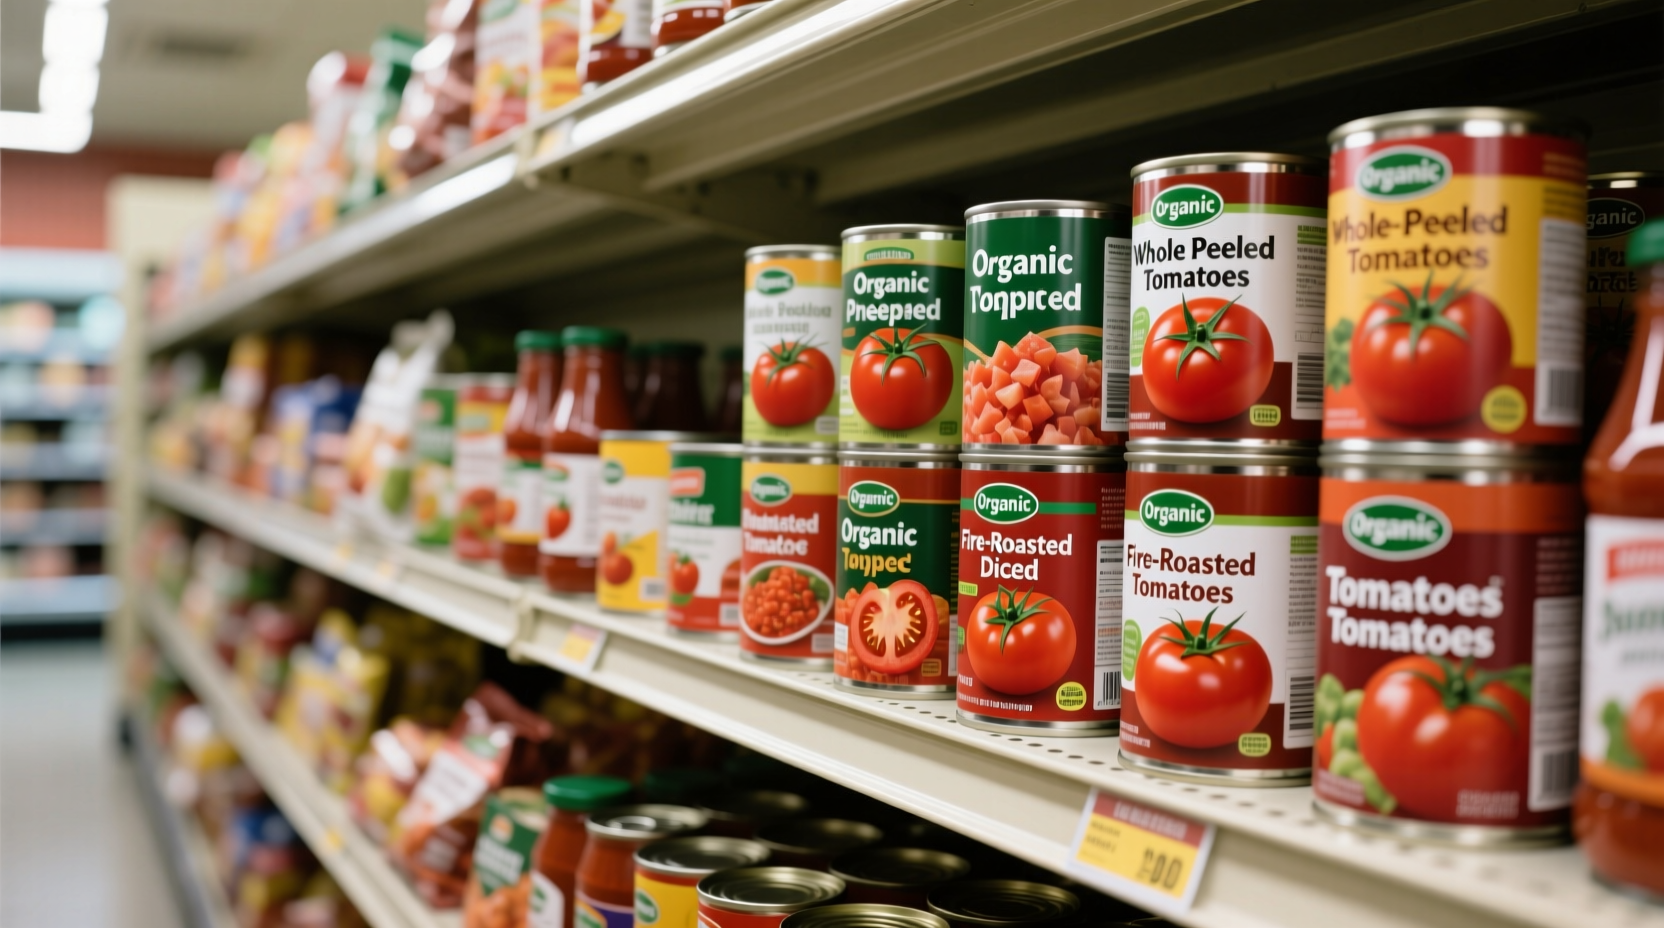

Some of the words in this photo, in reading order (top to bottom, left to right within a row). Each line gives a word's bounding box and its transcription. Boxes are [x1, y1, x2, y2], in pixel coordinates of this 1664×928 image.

[1361, 159, 1441, 193] Organic
[1155, 194, 1216, 221] Organic
[1586, 207, 1637, 230] ganic
[1332, 205, 1508, 244] Whole-Peeled
[972, 245, 1073, 283] Organic
[1134, 237, 1186, 266] Whole
[1191, 235, 1275, 260] Peeled
[1347, 243, 1488, 273] Tomatoes
[853, 270, 930, 299] Organic
[1143, 267, 1250, 291] Tomatoes
[977, 493, 1031, 515] Organic
[1144, 501, 1205, 526] Organic
[841, 517, 918, 550] Organic
[961, 528, 1073, 556] Fire-Roasted
[1350, 511, 1441, 547] Organic
[980, 555, 1039, 581] Diced
[1127, 543, 1256, 576] Fire-Roasted
[1132, 573, 1234, 604] Tomatoes
[1325, 564, 1503, 618] Tomatoes
[1326, 606, 1495, 658] Tomatoes
